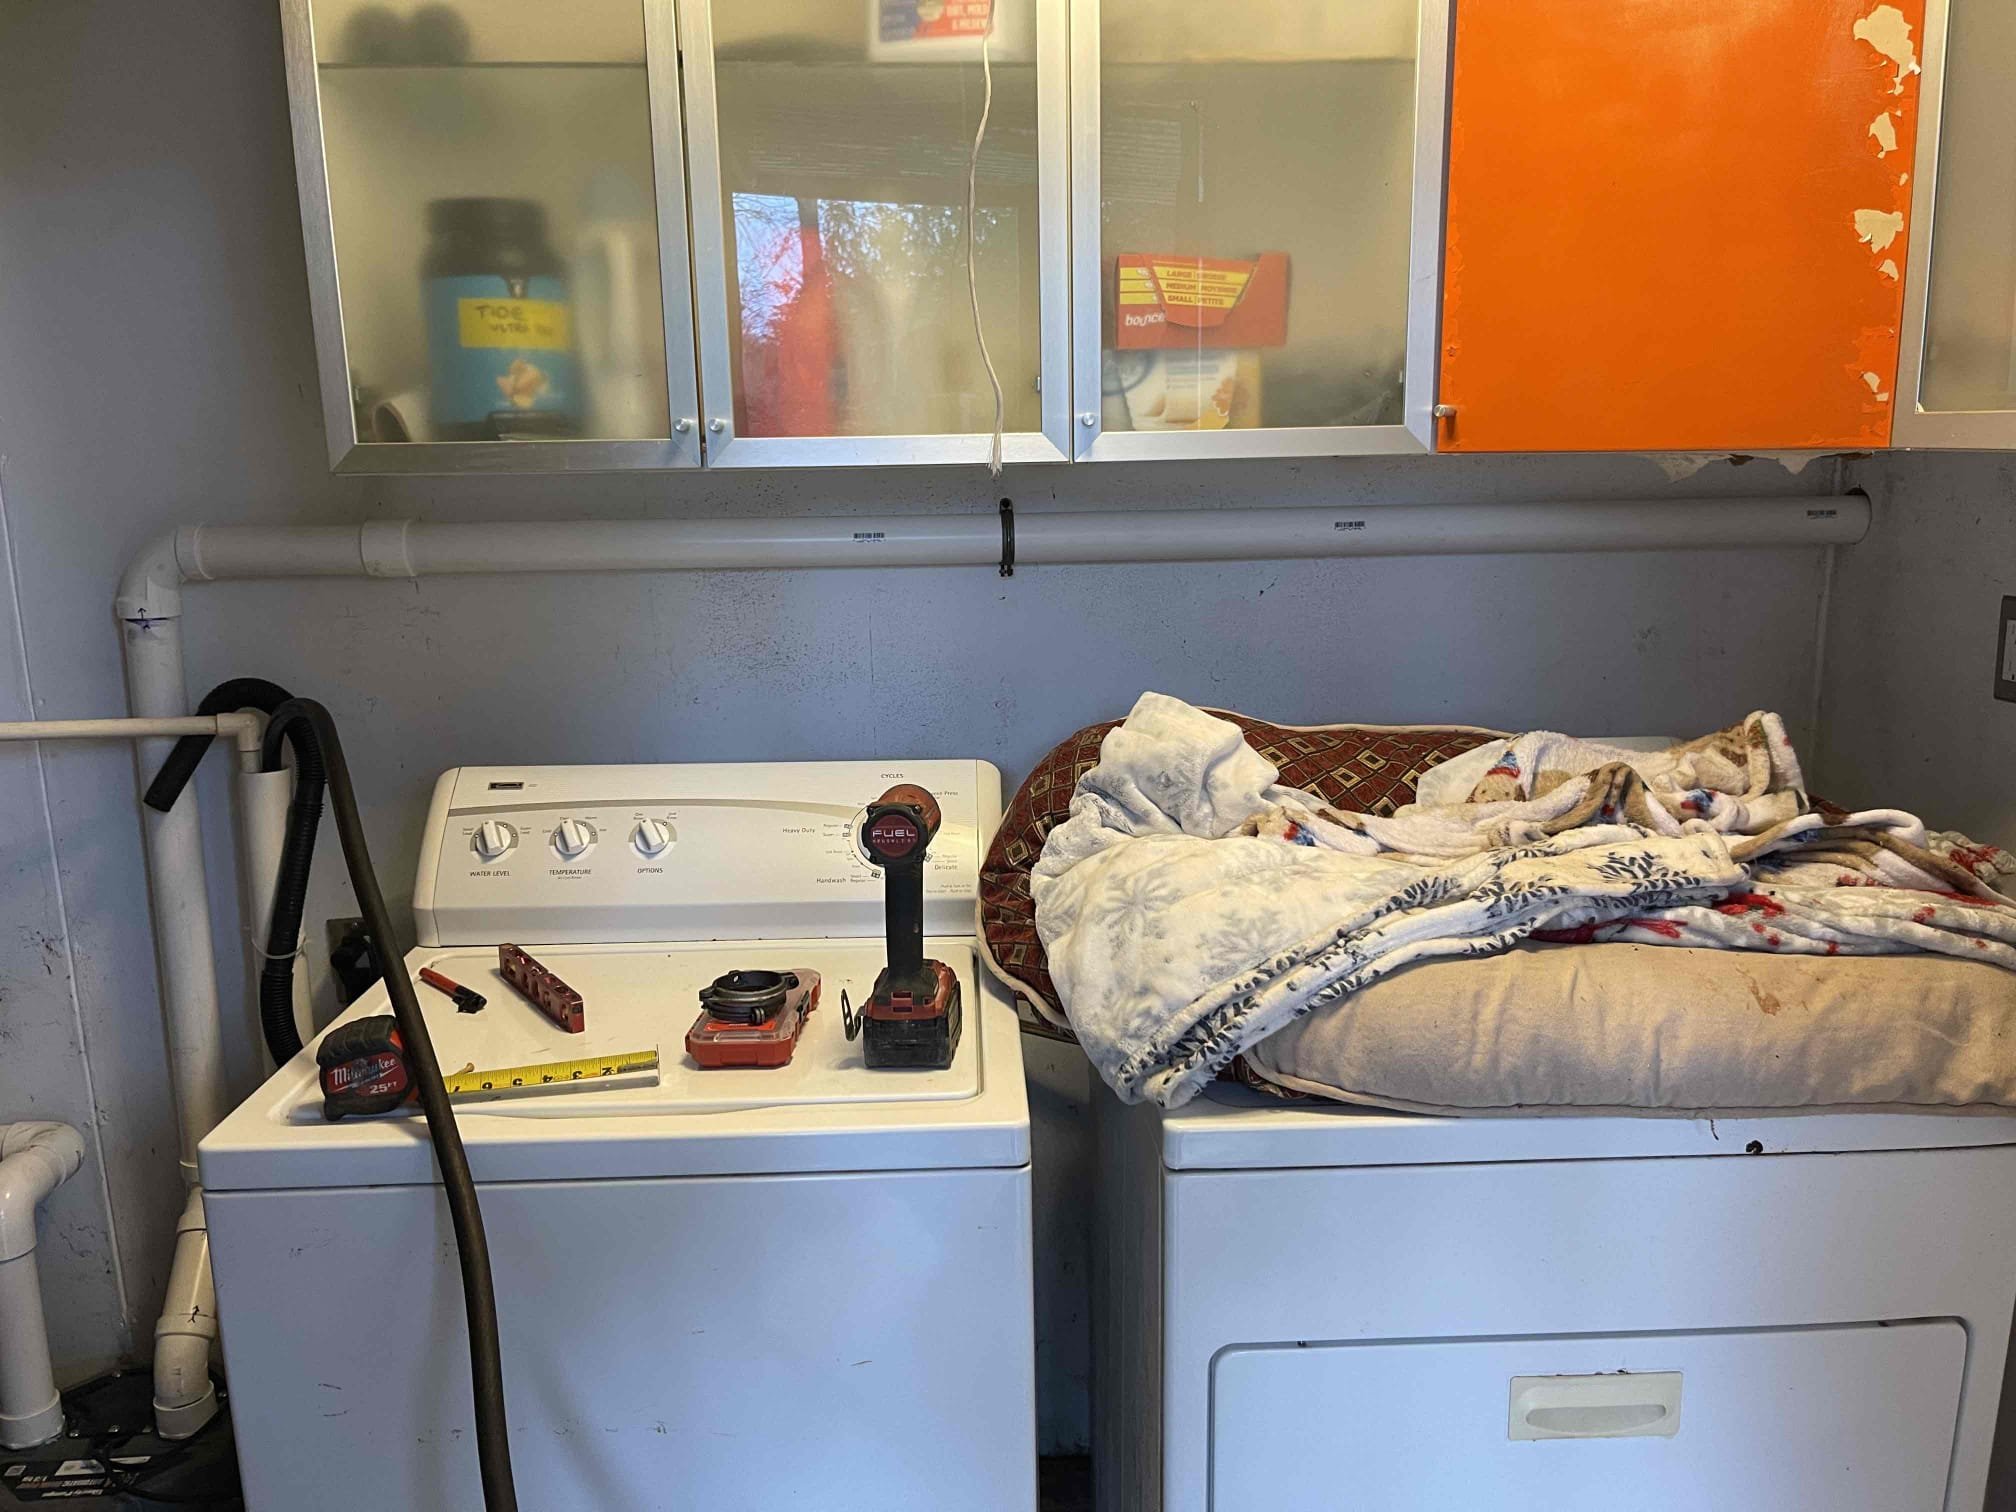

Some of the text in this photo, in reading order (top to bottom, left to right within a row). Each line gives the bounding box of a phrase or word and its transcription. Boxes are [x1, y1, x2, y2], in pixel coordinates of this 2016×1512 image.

[1166, 269, 1192, 279] LARGE
[1165, 282, 1196, 291] MEDIUM
[1167, 295, 1193, 304] SMALL
[1125, 312, 1165, 327] bounce
[872, 829, 915, 838] FUEL
[549, 868, 592, 876] TEMPERATURE
